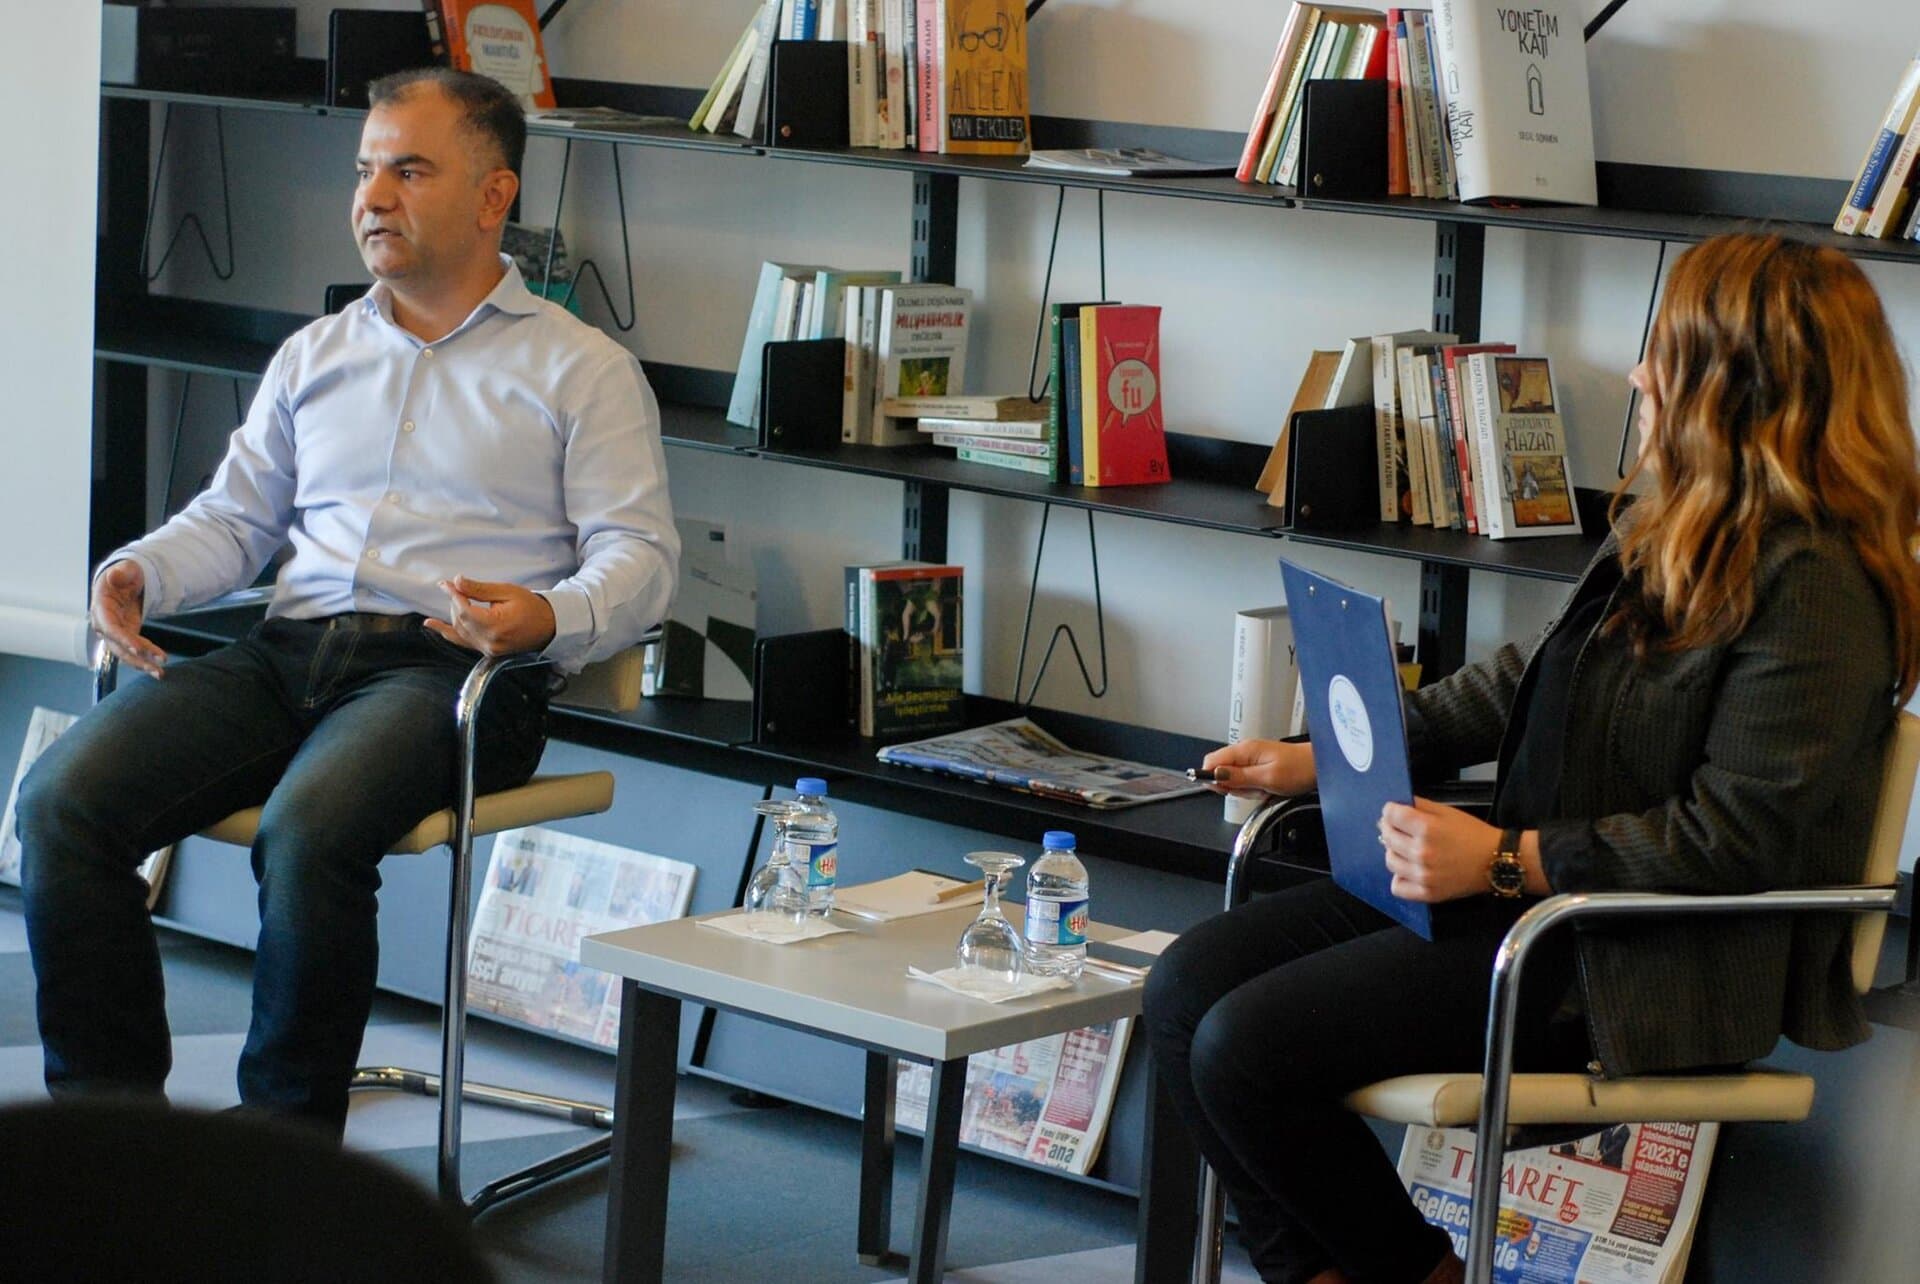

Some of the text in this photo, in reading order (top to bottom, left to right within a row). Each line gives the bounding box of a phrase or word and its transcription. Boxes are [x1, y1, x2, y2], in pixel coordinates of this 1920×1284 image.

[924, 49, 932, 90] ARAYAN
[951, 69, 1023, 111] ALLEN
[924, 92, 932, 121] ADAM
[950, 117, 971, 138] YAN
[1121, 380, 1142, 408] fu
[1505, 427, 1556, 452] HAZAN
[1048, 1144, 1074, 1164] ana
[1637, 1140, 1689, 1169] 2023'e
